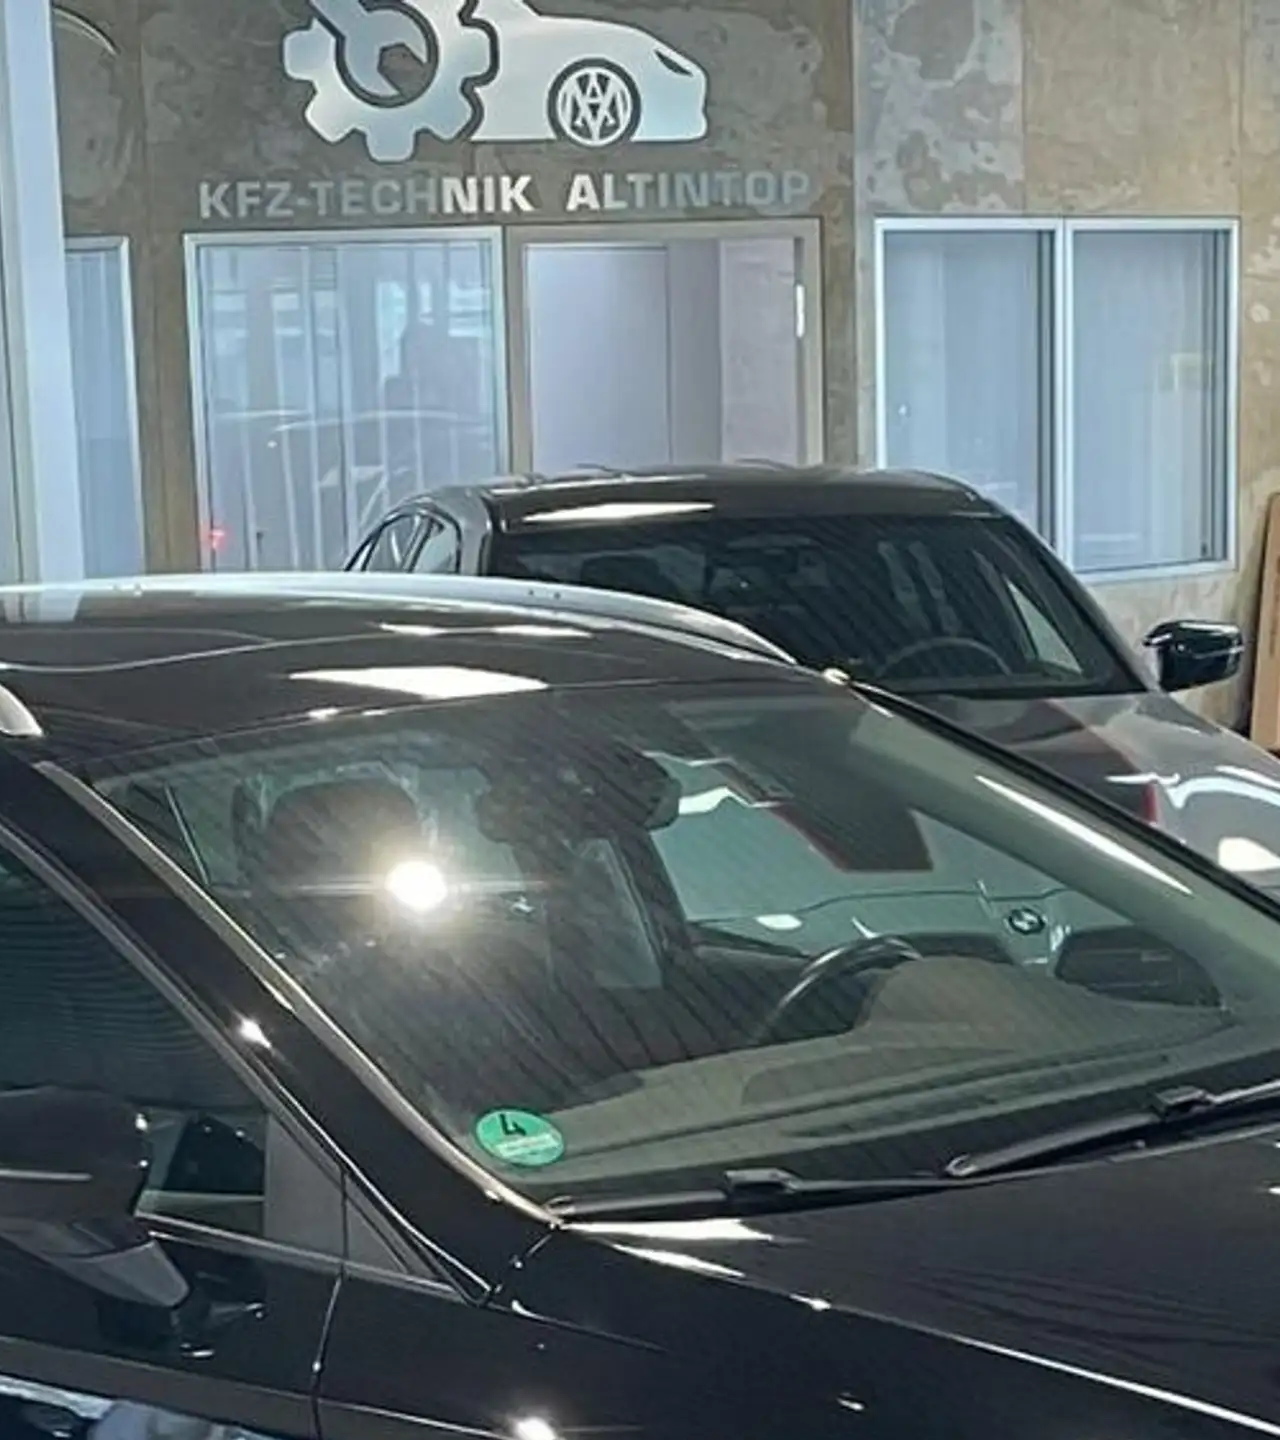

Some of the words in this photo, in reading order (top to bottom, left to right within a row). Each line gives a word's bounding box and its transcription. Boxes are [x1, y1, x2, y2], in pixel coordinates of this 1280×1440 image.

[199, 174, 535, 218] KFZ-TECHNIK
[567, 170, 811, 211] ALTINTOP
[499, 1113, 527, 1136] 4
